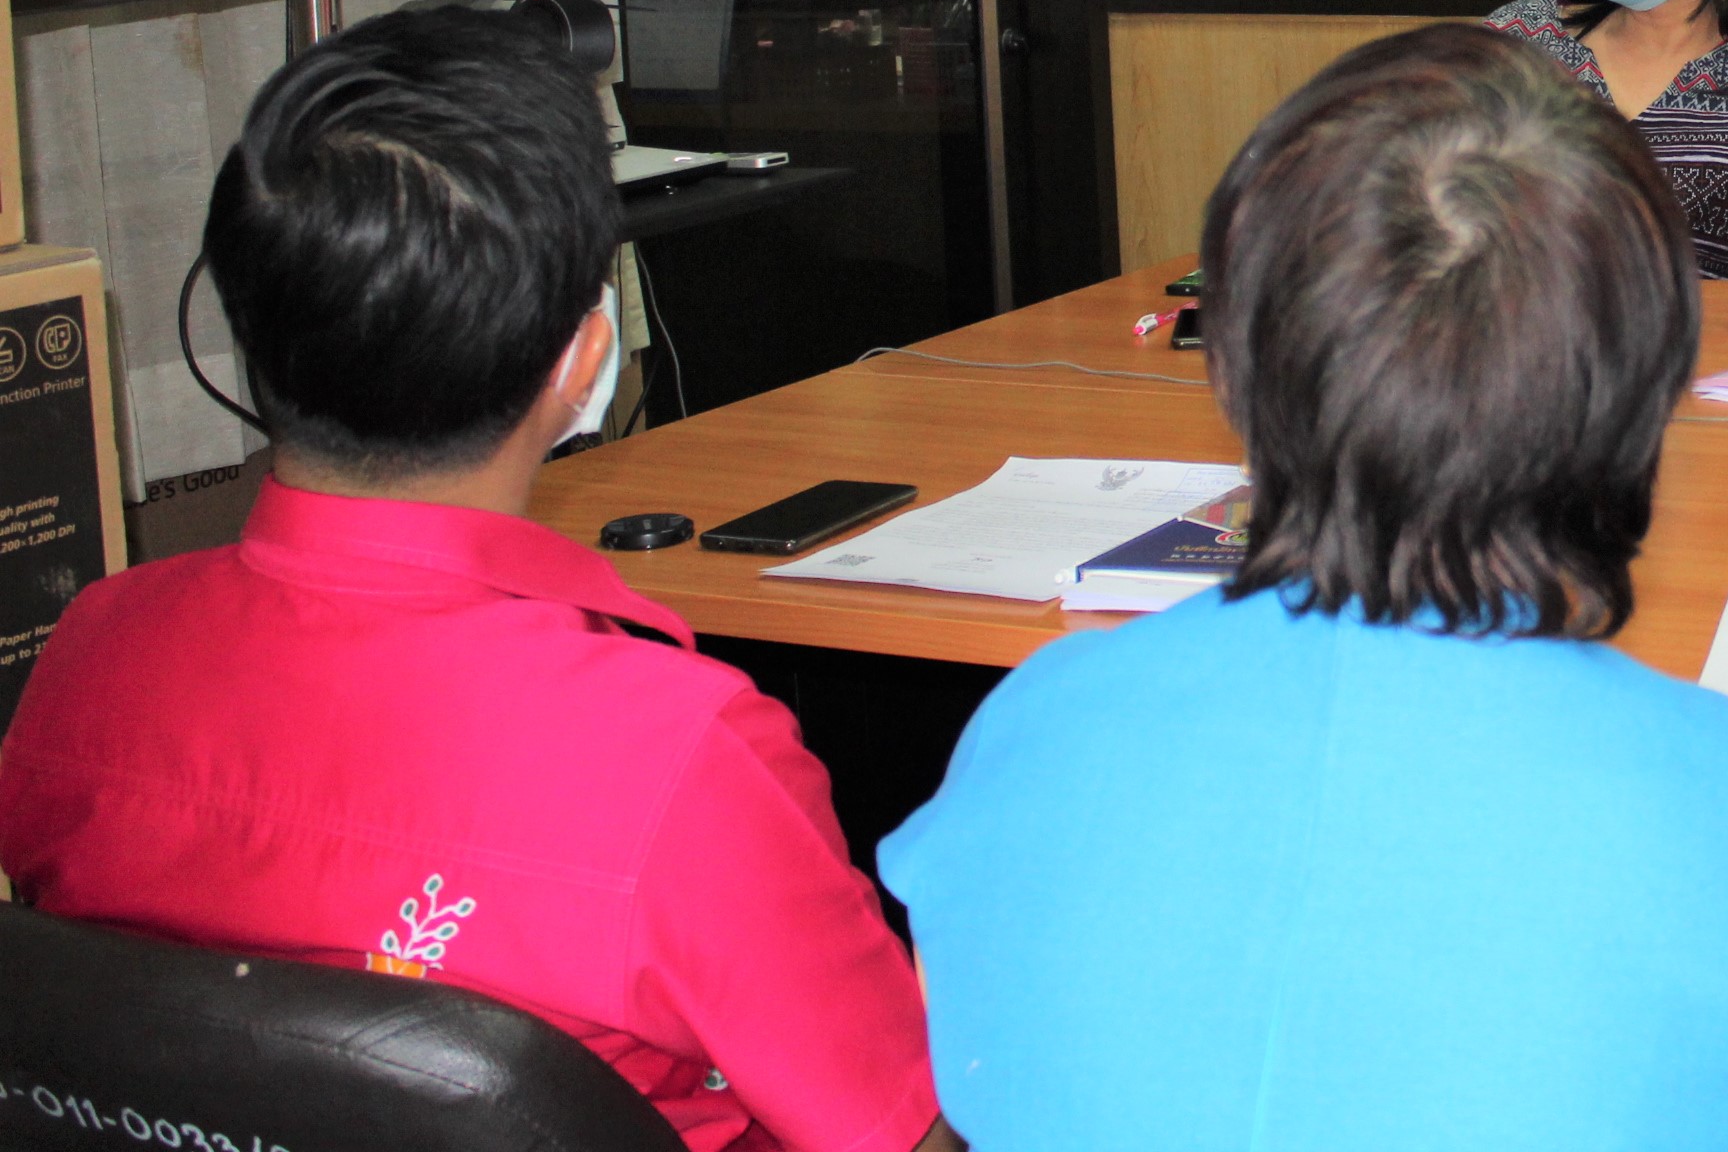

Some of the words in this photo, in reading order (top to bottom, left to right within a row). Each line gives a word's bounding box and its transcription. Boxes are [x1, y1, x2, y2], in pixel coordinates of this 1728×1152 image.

[0, 386, 41, 406] nction
[43, 376, 86, 395] Printer
[0, 506, 14, 522] gh
[15, 495, 60, 517] printing
[0, 520, 28, 537] uality
[30, 512, 56, 527] with
[57, 524, 76, 538] DPI
[0, 630, 32, 648] Paper
[1, 654, 16, 666] up
[19, 648, 32, 659] to
